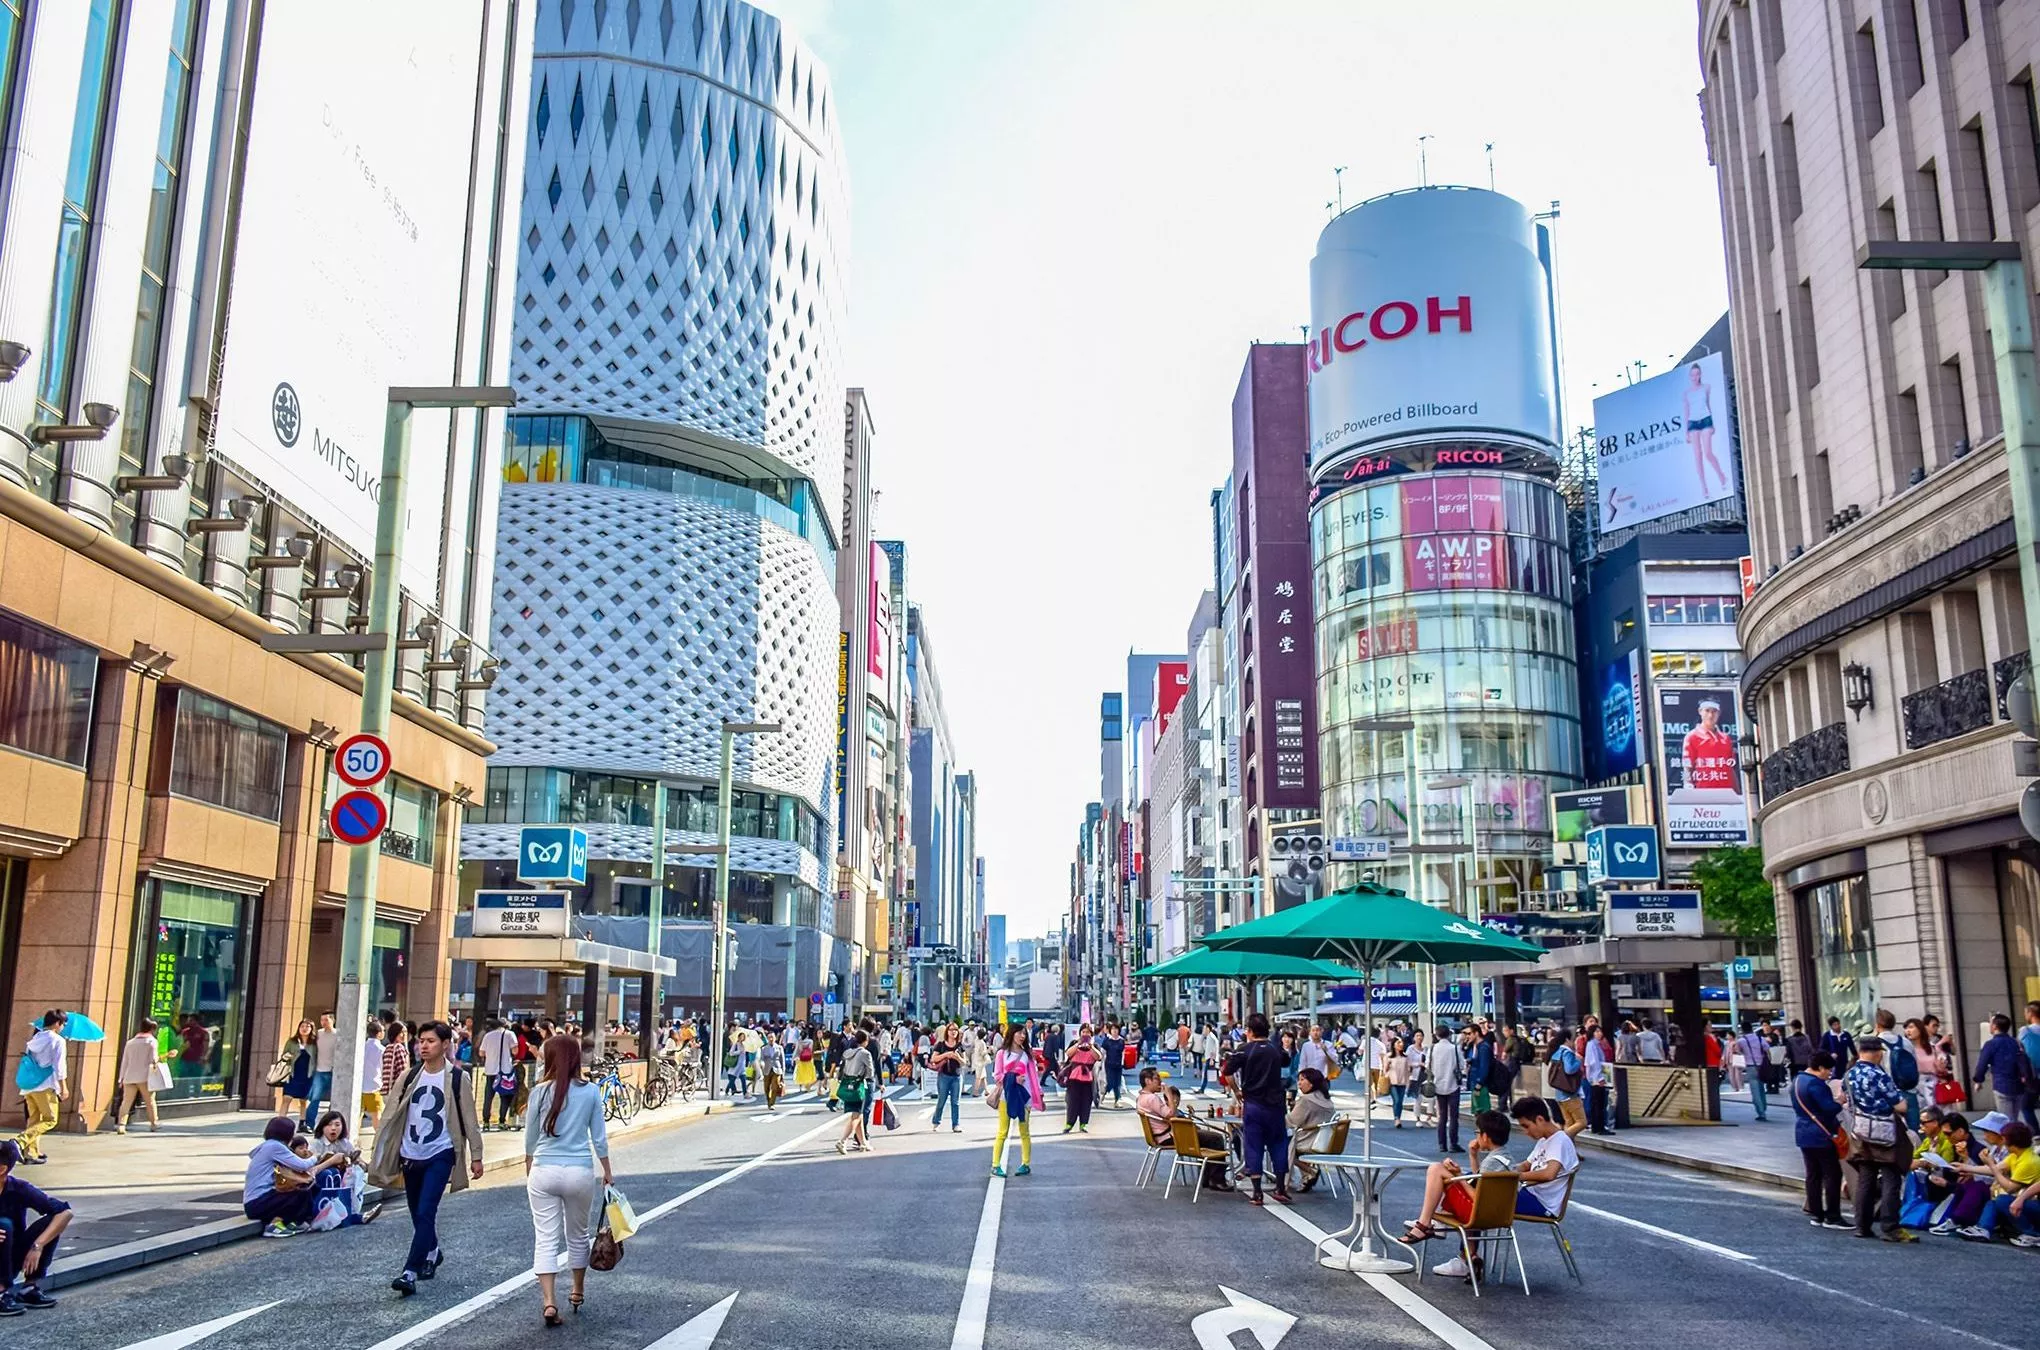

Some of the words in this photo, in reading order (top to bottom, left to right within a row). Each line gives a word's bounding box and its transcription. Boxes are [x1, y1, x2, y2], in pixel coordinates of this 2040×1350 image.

[1307, 296, 1472, 385] RICOH
[1325, 408, 1401, 445] Eco-Powered
[1406, 402, 1478, 418] Billboard
[1625, 415, 1682, 447] RAPAS
[1437, 450, 1503, 464] RICOH
[1274, 580, 1295, 653] 鳩居堂
[1359, 626, 1413, 655] SALE
[347, 749, 378, 773] 50
[1693, 808, 1721, 818] New
[1669, 818, 1727, 829] airweave
[501, 911, 540, 923] 銀座駅
[1635, 912, 1675, 924] 銀座駅
[501, 923, 523, 931] Ginza
[1637, 924, 1659, 932] Ginza
[1660, 924, 1675, 932] Sta.
[409, 1085, 445, 1145] 3
